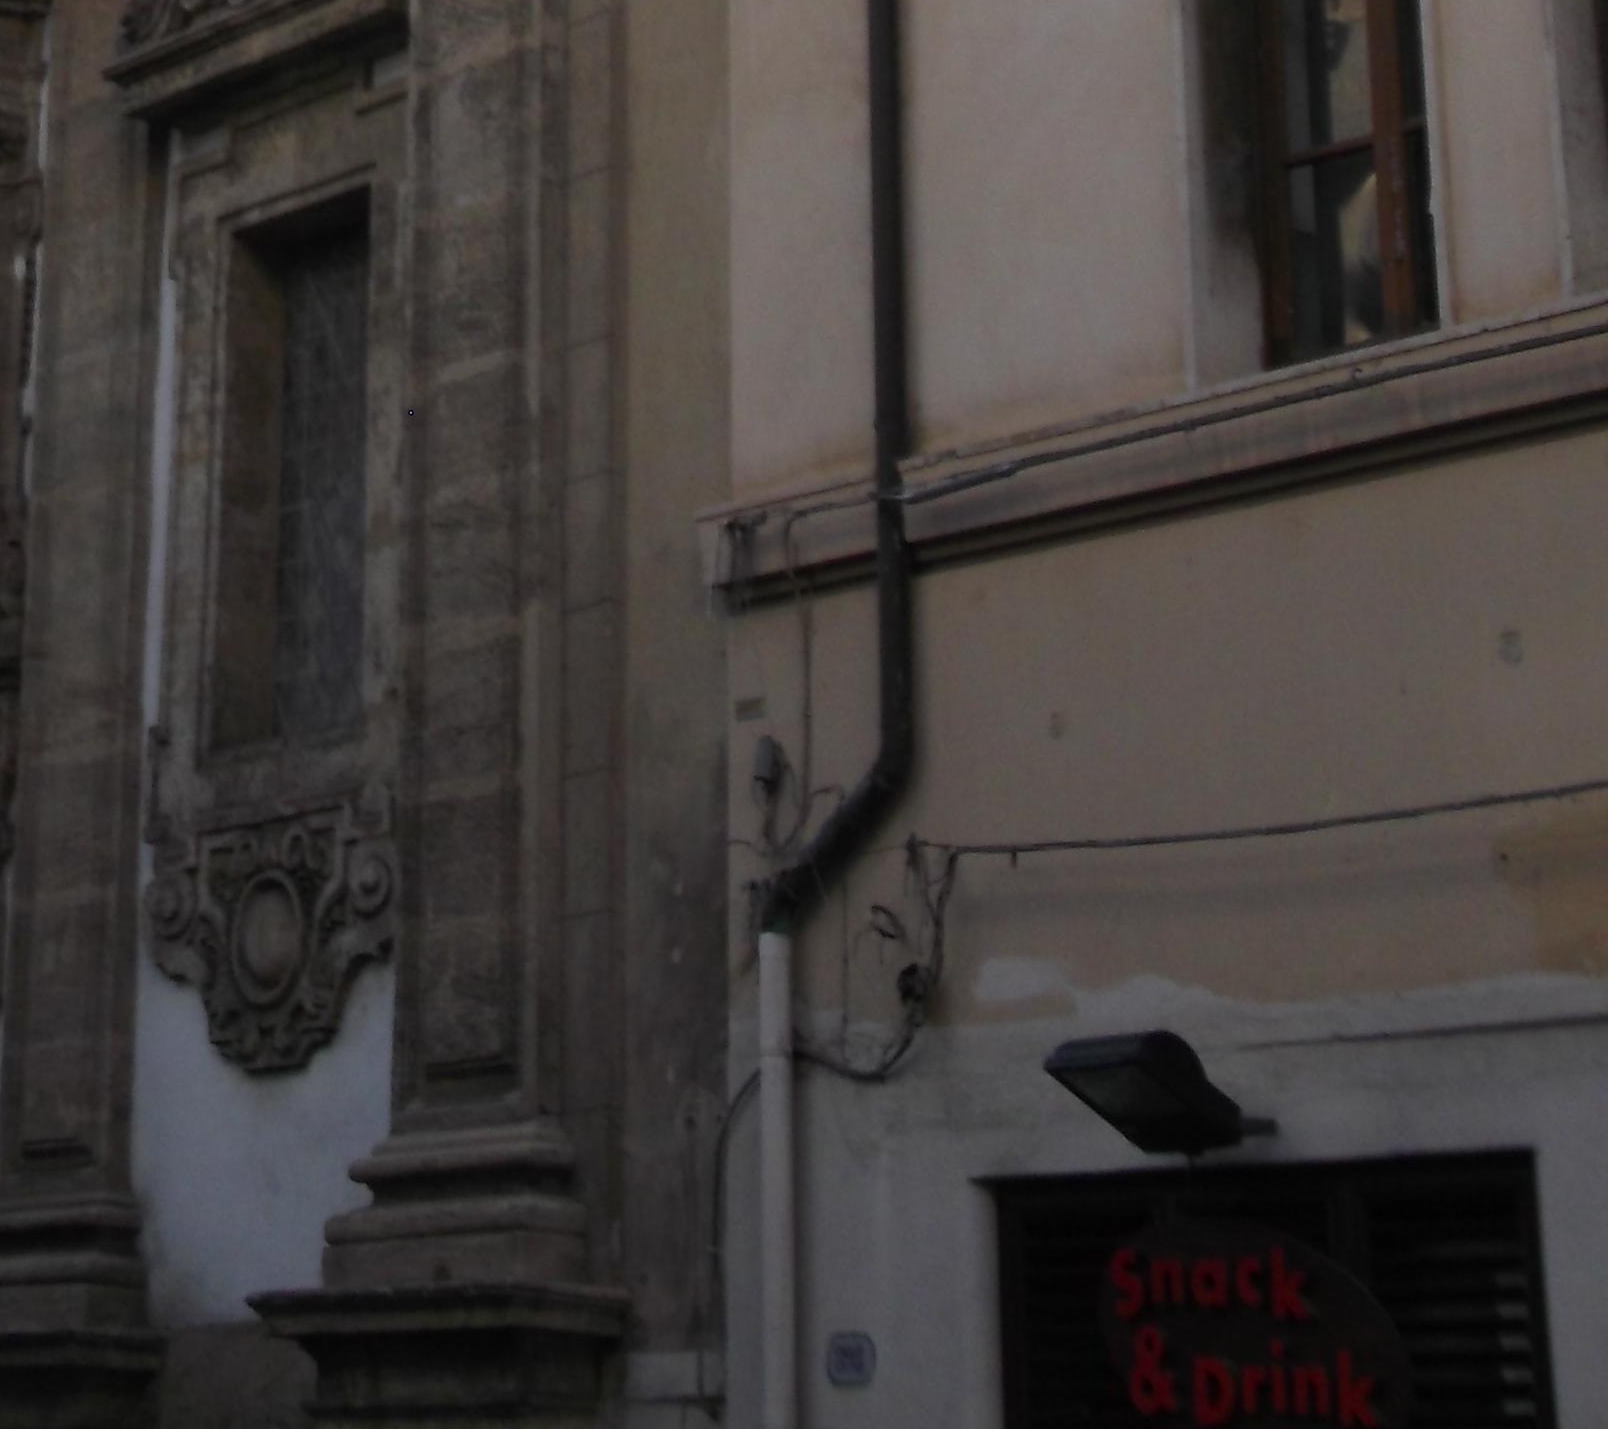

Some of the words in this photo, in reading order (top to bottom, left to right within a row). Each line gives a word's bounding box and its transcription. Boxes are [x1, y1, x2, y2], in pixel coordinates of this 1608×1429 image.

[1110, 1247, 1313, 1320] Snack
[1132, 1325, 1177, 1413] &
[1193, 1338, 1378, 1428] Drink
